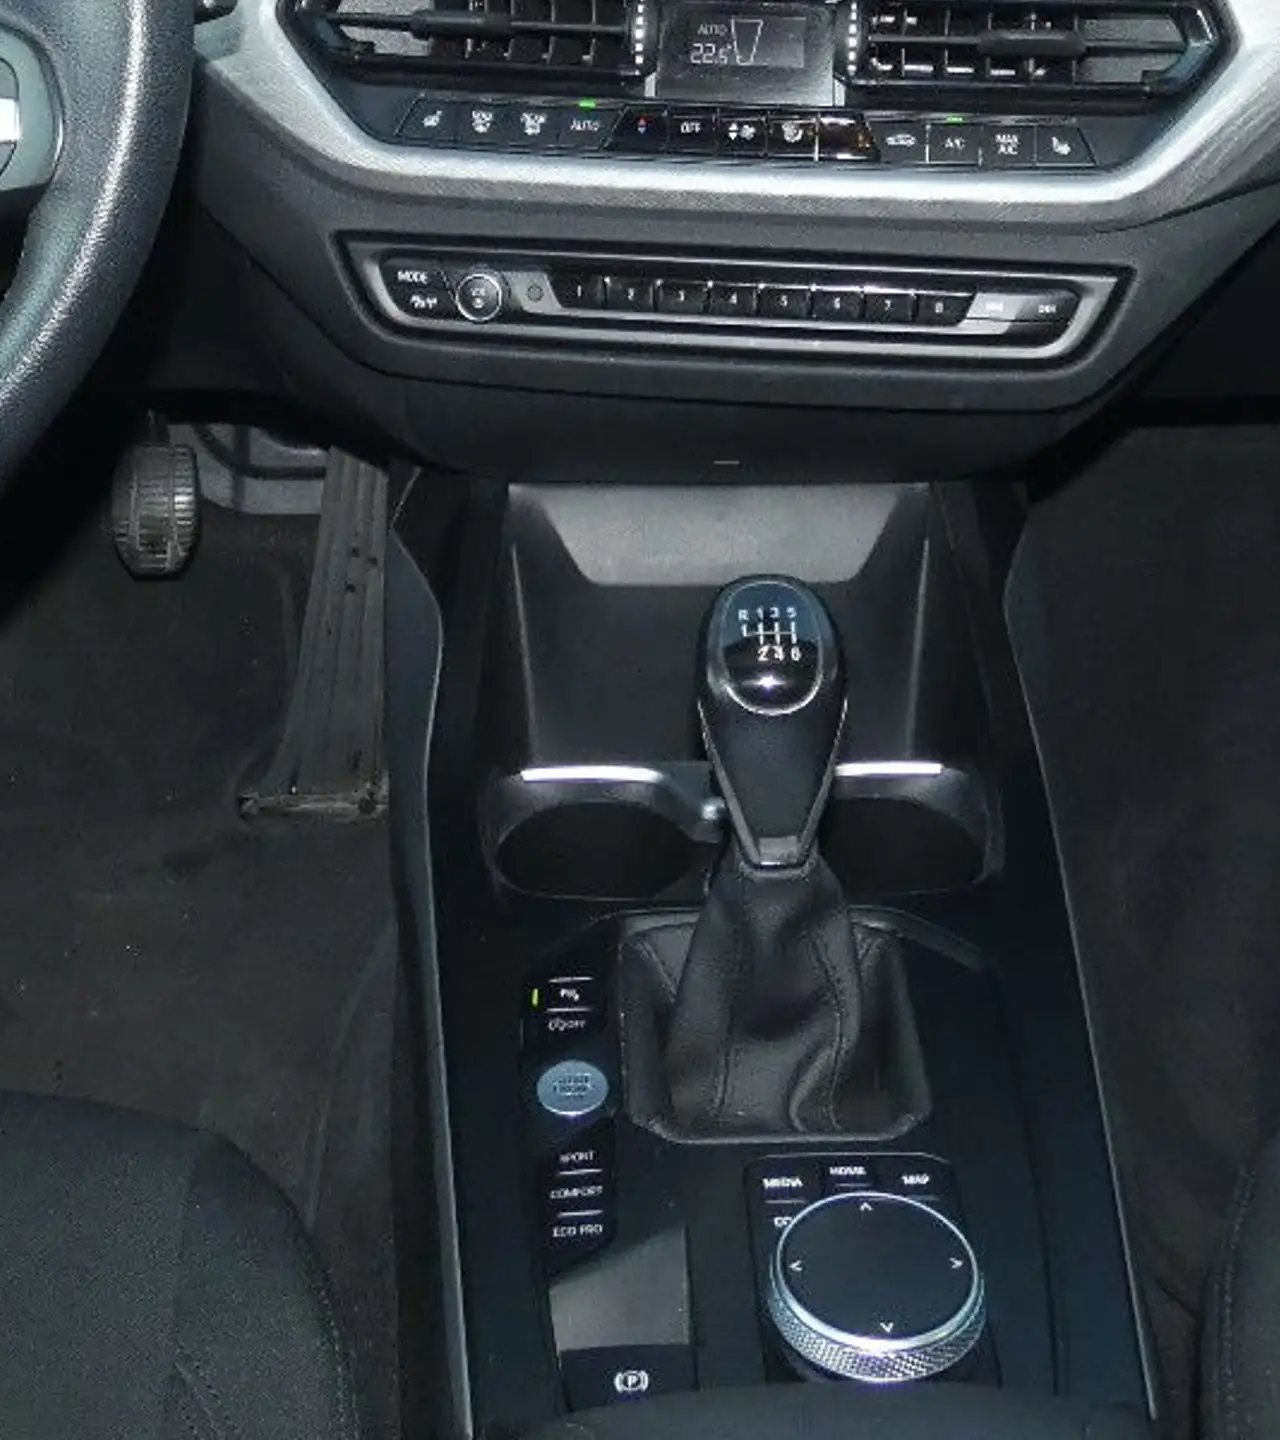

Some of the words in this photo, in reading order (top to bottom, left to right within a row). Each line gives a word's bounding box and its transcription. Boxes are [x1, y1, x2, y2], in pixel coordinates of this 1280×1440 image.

[698, 23, 728, 36] AUTO
[570, 119, 601, 132] AUTO
[679, 121, 702, 135] OFF
[396, 270, 428, 284] MODE
[627, 287, 635, 300] 2
[678, 289, 685, 302] 3
[729, 292, 738, 305] 4
[780, 294, 788, 307] 5
[833, 297, 841, 310] 6
[884, 299, 892, 312] 7
[738, 609, 749, 621] R
[770, 607, 780, 618] 3
[786, 607, 797, 618] 5
[757, 645, 770, 661] 2
[773, 646, 785, 661] 4
[790, 646, 802, 661] 6
[552, 1226, 577, 1237] ECO
